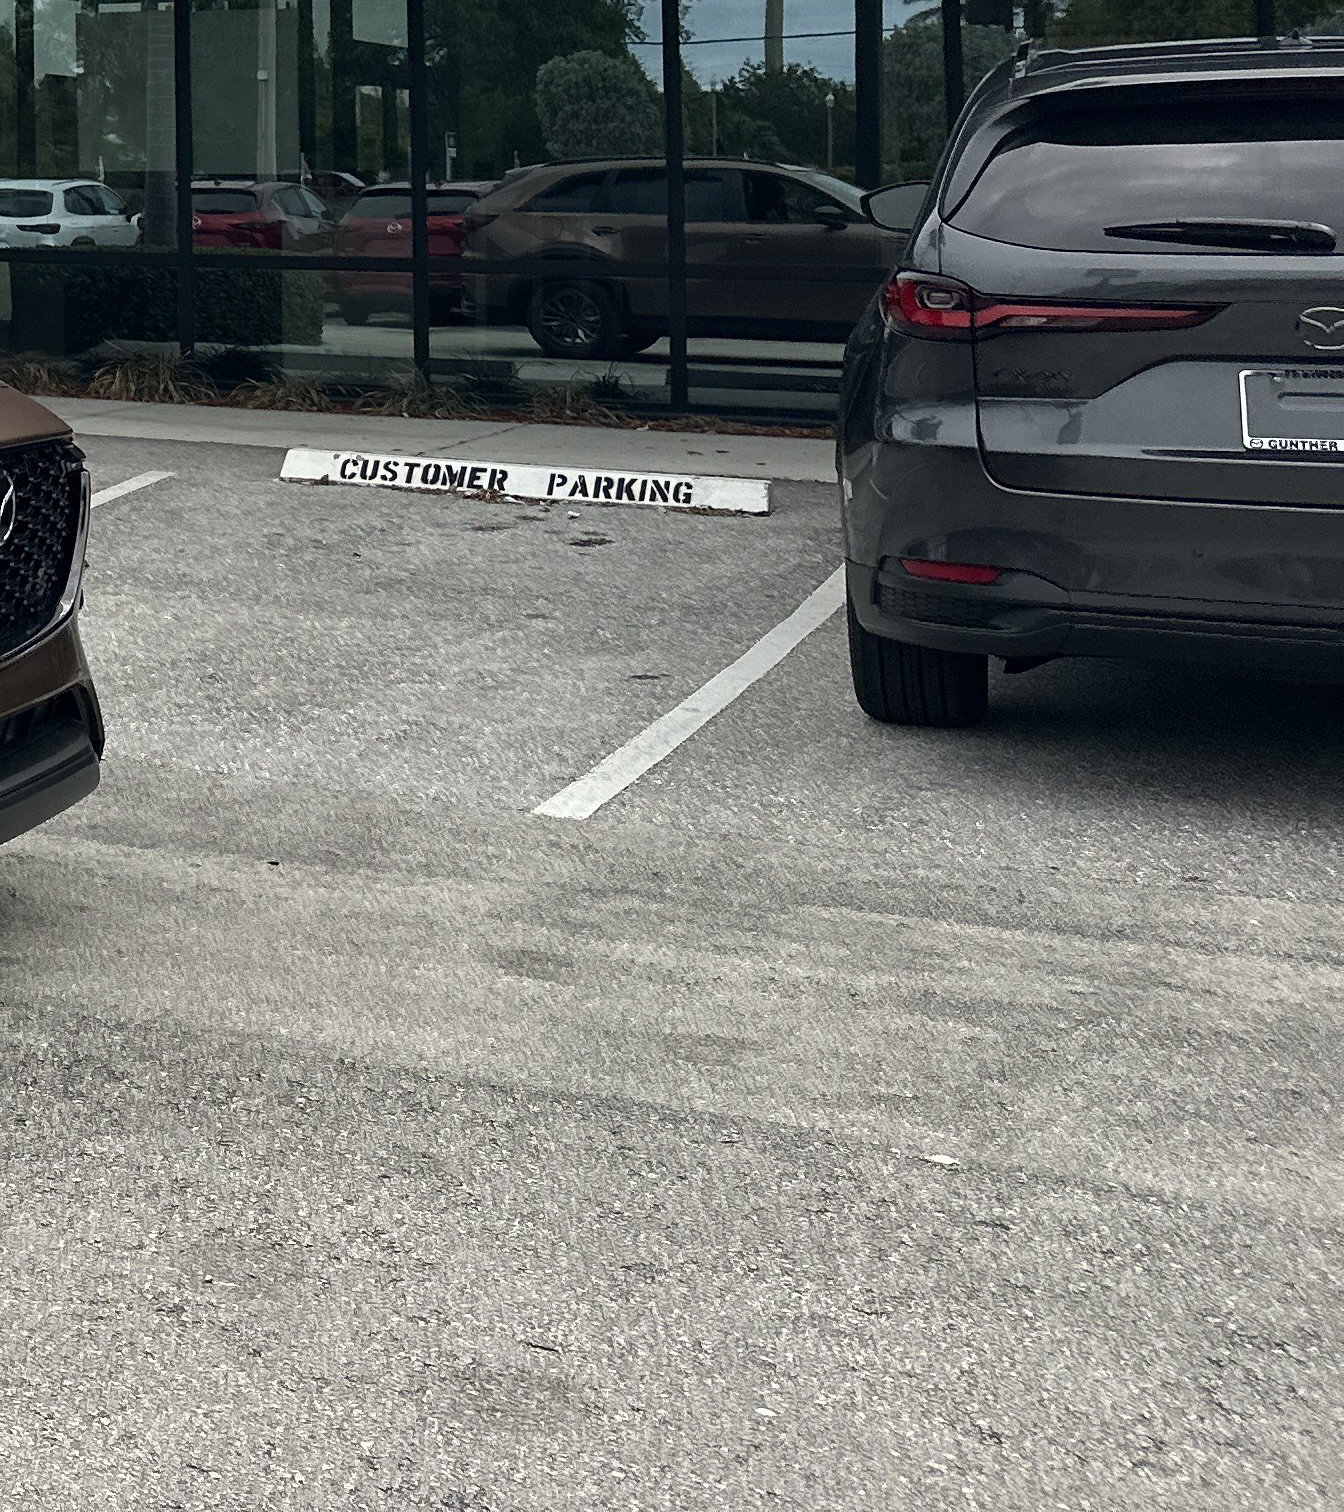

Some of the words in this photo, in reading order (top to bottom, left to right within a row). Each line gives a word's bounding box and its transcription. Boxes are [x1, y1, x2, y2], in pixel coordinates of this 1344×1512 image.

[1267, 439, 1338, 451] GUNTHER
[339, 457, 509, 493] CUSTOMER
[547, 473, 694, 505] PARKING
